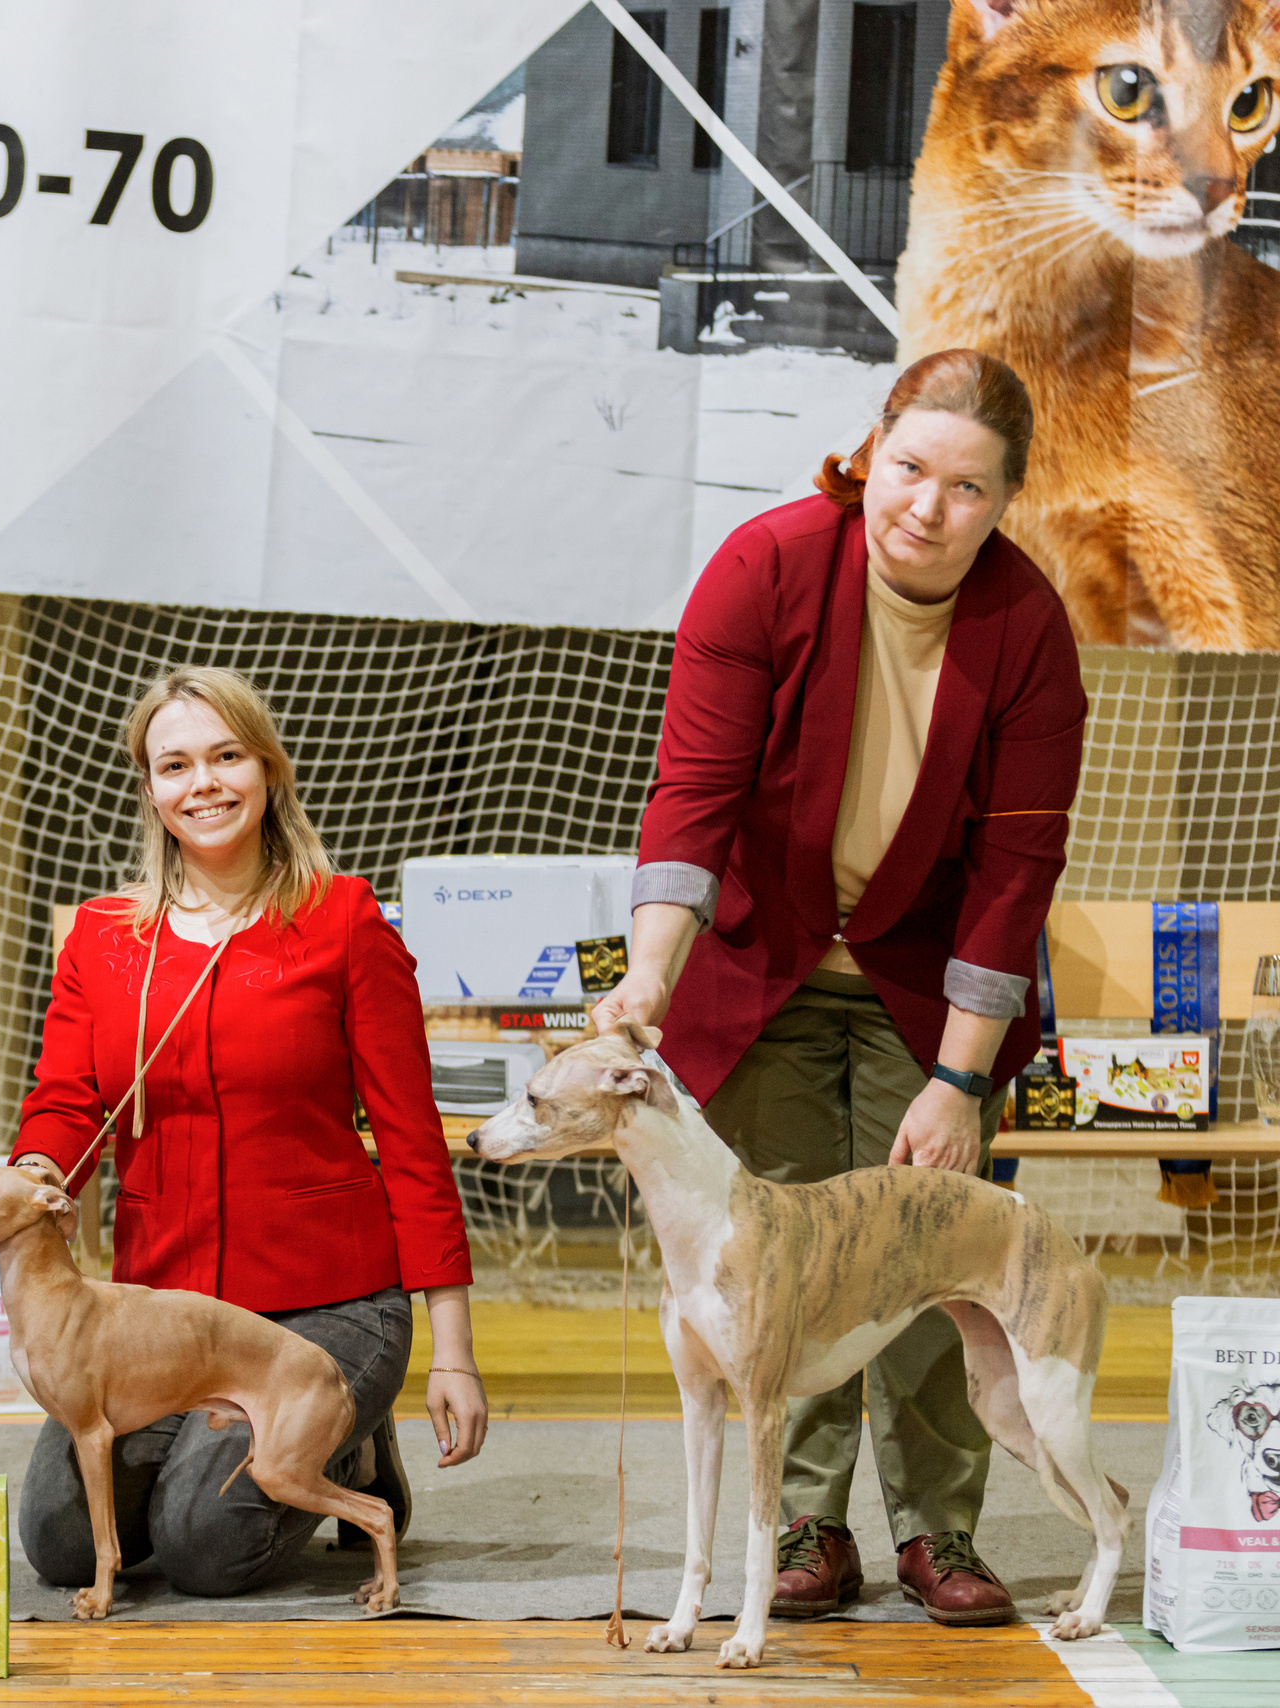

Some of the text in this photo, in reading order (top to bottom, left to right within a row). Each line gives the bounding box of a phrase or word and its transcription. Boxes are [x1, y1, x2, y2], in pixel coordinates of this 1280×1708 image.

[457, 889, 513, 901] DEXP
[499, 1013, 590, 1028] STARWIND
[1215, 1349, 1257, 1364] BEST
[1238, 1537, 1270, 1547] VEAL
[1245, 1625, 1280, 1633] SENSIB
